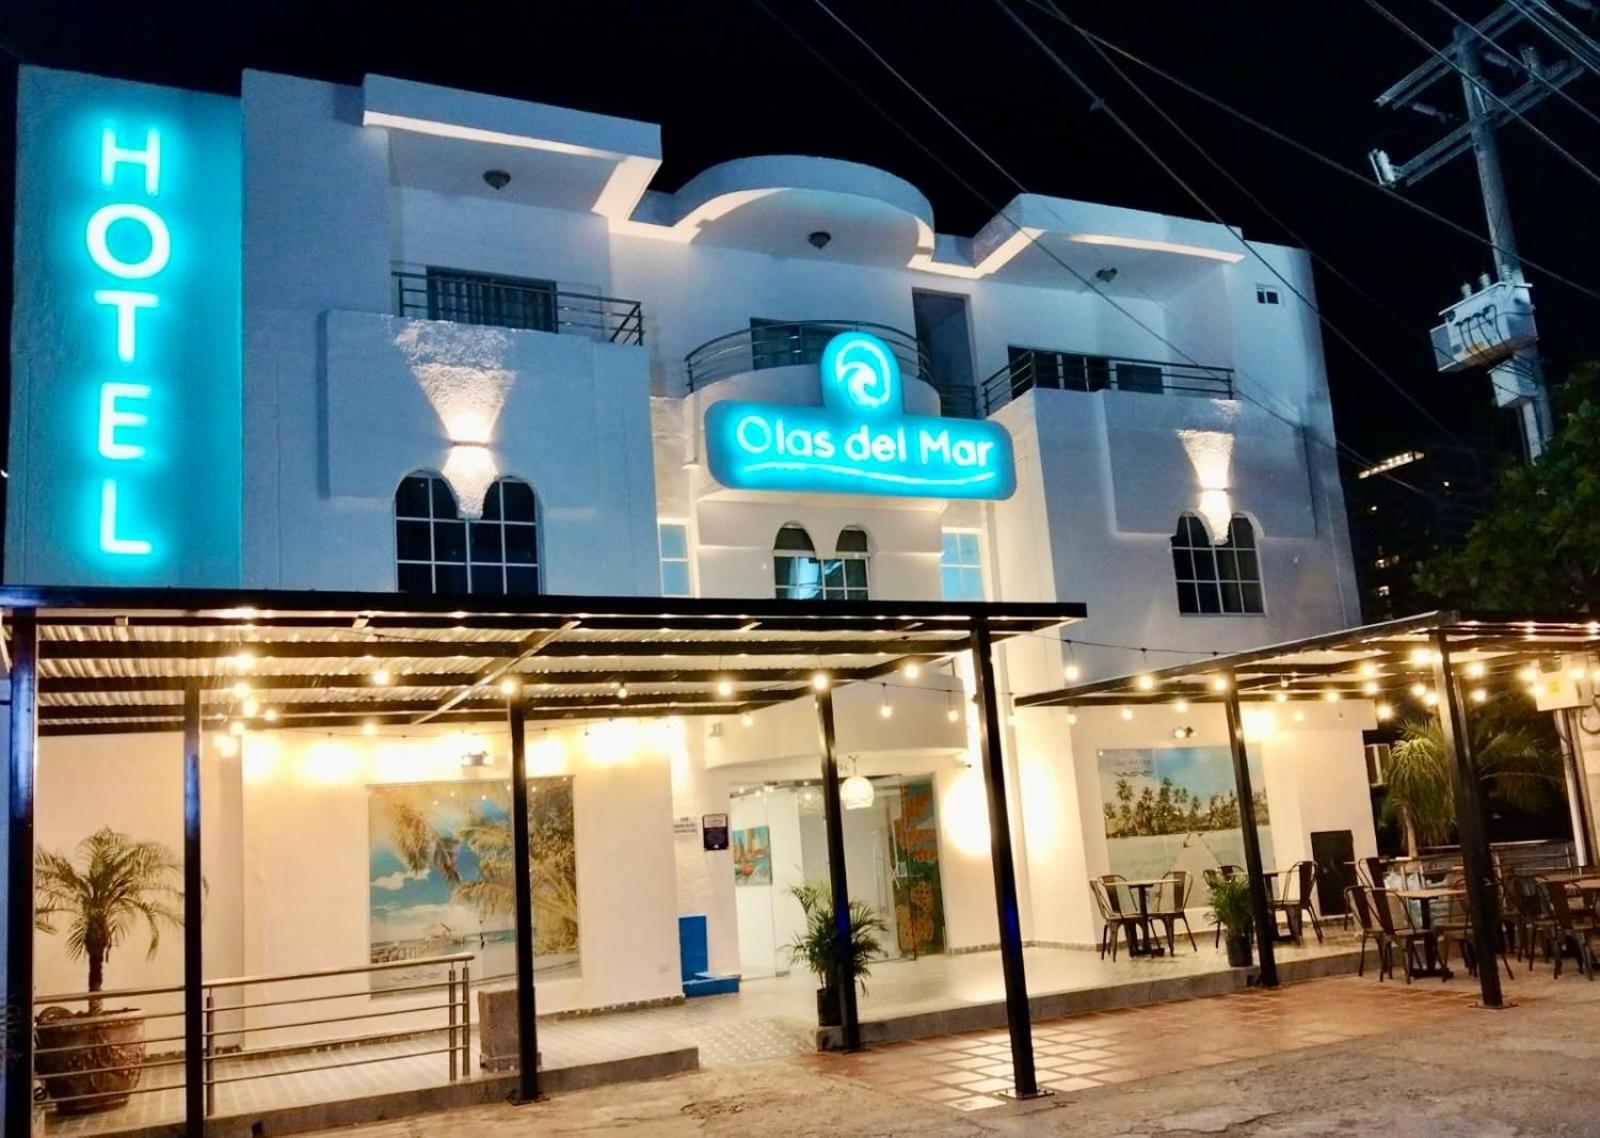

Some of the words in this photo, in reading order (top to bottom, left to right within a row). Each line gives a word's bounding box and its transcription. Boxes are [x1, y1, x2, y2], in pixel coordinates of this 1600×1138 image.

[86, 126, 171, 556] HOTEL
[736, 415, 835, 458] Olas
[845, 424, 908, 463] del
[918, 427, 994, 467] Mar
